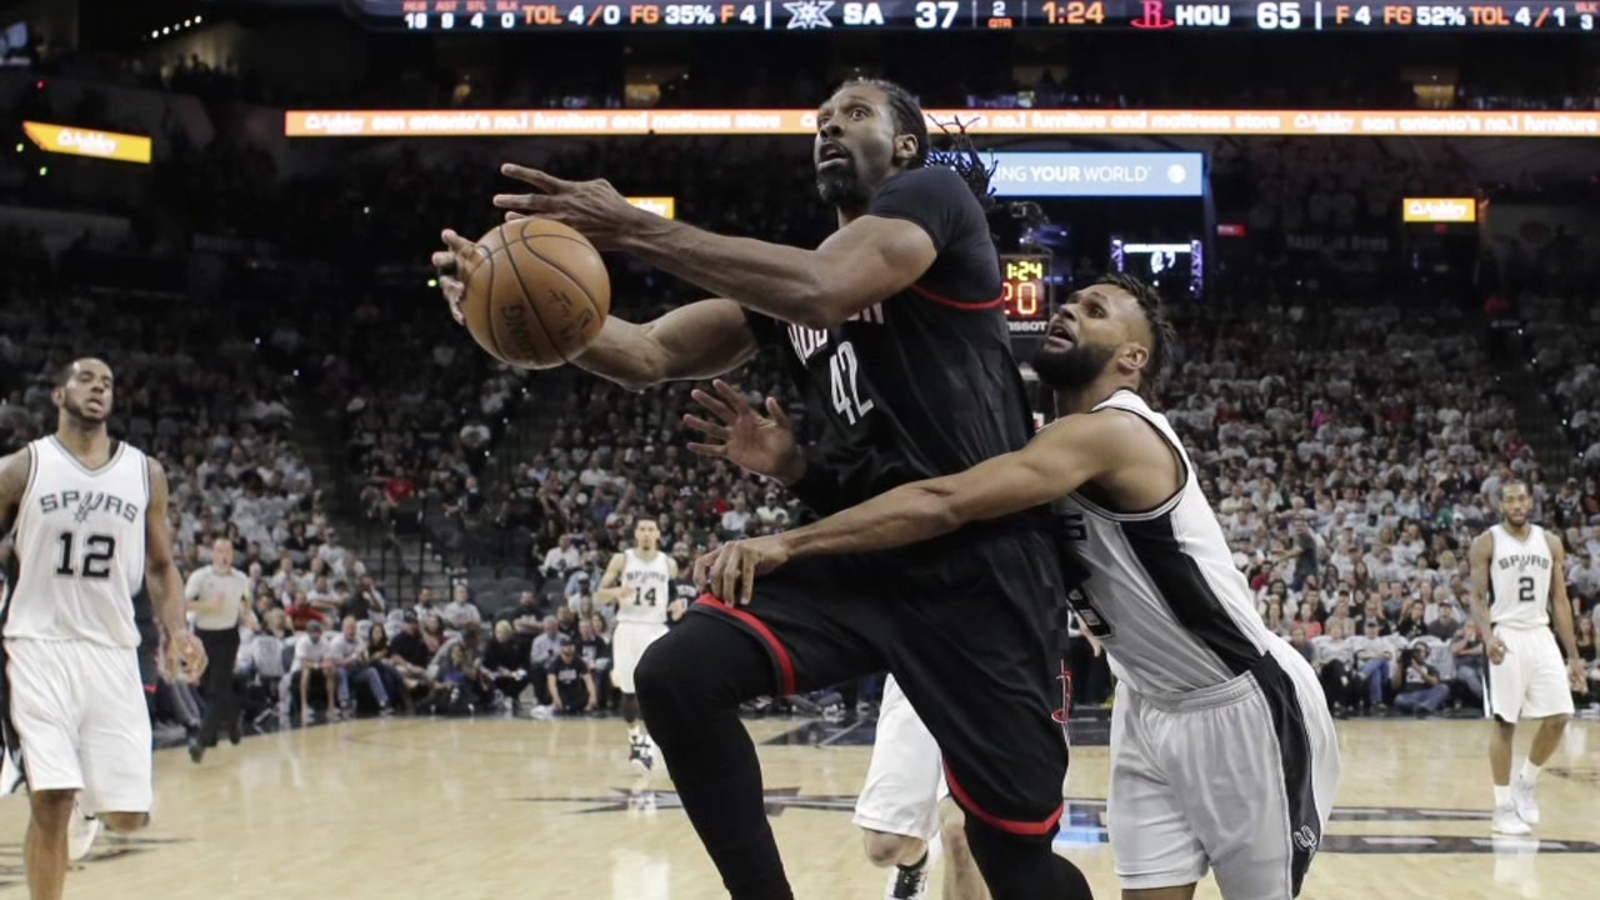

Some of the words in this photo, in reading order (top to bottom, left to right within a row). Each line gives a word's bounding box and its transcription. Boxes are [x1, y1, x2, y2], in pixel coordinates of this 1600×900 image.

[523, 5, 563, 25] TOL
[630, 5, 659, 24] FG
[665, 5, 715, 25] 35%
[720, 5, 734, 24] F
[739, 5, 757, 25] 4
[843, 2, 884, 25] SA
[914, 1, 958, 29] 37
[993, 1, 1005, 17] 2
[1041, 2, 1104, 24] 1:24
[1175, 5, 1230, 26] HOU
[1256, 2, 1301, 30] 65
[1336, 6, 1350, 25] F
[1354, 6, 1371, 26] 4
[1384, 6, 1413, 25] FG
[1416, 6, 1466, 26] 52%
[1470, 7, 1510, 26] TOL
[470, 12, 484, 29] 4
[501, 12, 515, 29] 0
[1580, 14, 1593, 30] 3
[371, 115, 405, 131] san
[532, 112, 609, 130] furniture
[611, 111, 648, 130] and
[651, 112, 731, 130] mattress
[734, 113, 780, 130] store
[1030, 111, 1107, 129] furniture
[1110, 111, 1147, 129] and
[1150, 112, 1231, 129] mattress
[1234, 113, 1281, 129] store
[1360, 115, 1394, 131] san
[1523, 114, 1599, 133] furniture
[1029, 165, 1082, 183] YOUR
[1083, 166, 1149, 183] WORLD
[1007, 261, 1043, 281] 1:24
[829, 341, 874, 425] 42
[39, 490, 139, 523] SPURS
[55, 530, 116, 579] 12
[633, 587, 656, 606] 14
[1518, 577, 1535, 602] 2
